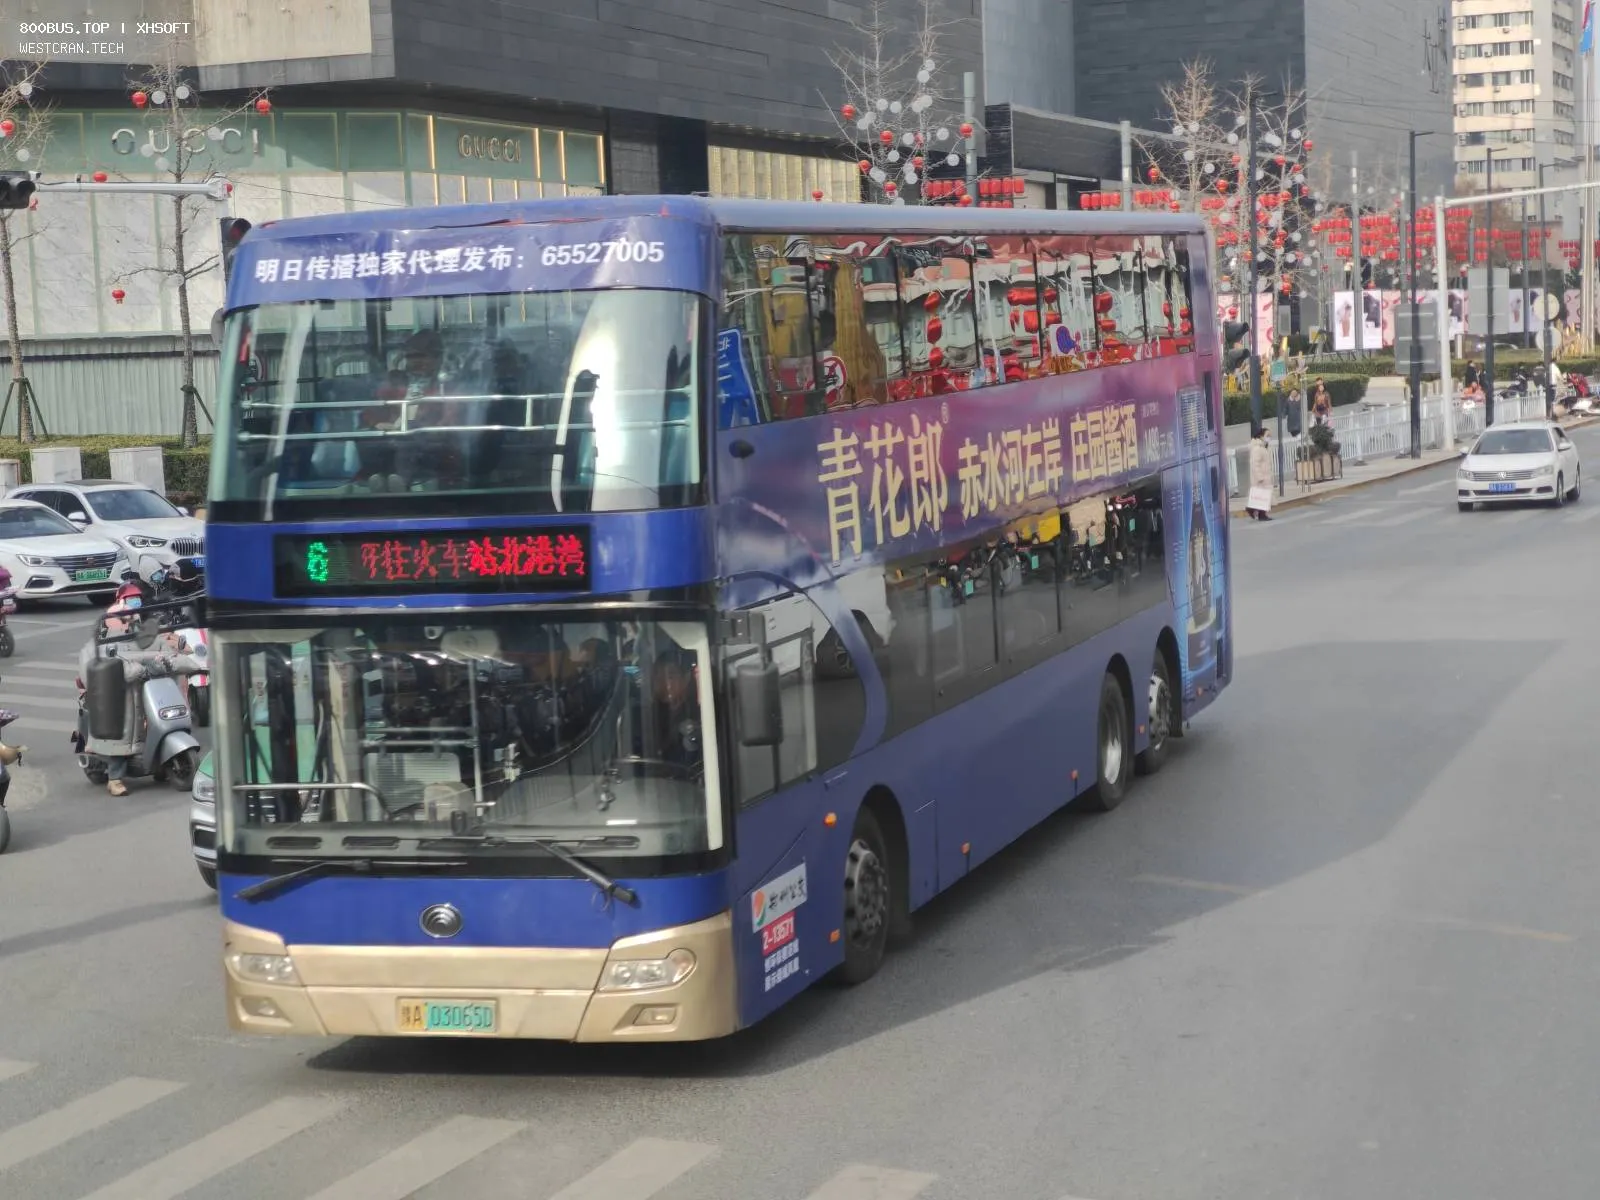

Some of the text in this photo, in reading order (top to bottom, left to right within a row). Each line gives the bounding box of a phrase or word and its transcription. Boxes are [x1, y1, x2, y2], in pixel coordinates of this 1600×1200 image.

[111, 127, 260, 156] GUCCI
[458, 134, 522, 163] GUCCI
[541, 237, 665, 266] 65527005
[817, 404, 1139, 568] 青花郎 赤水河左岸 庄园酱酒
